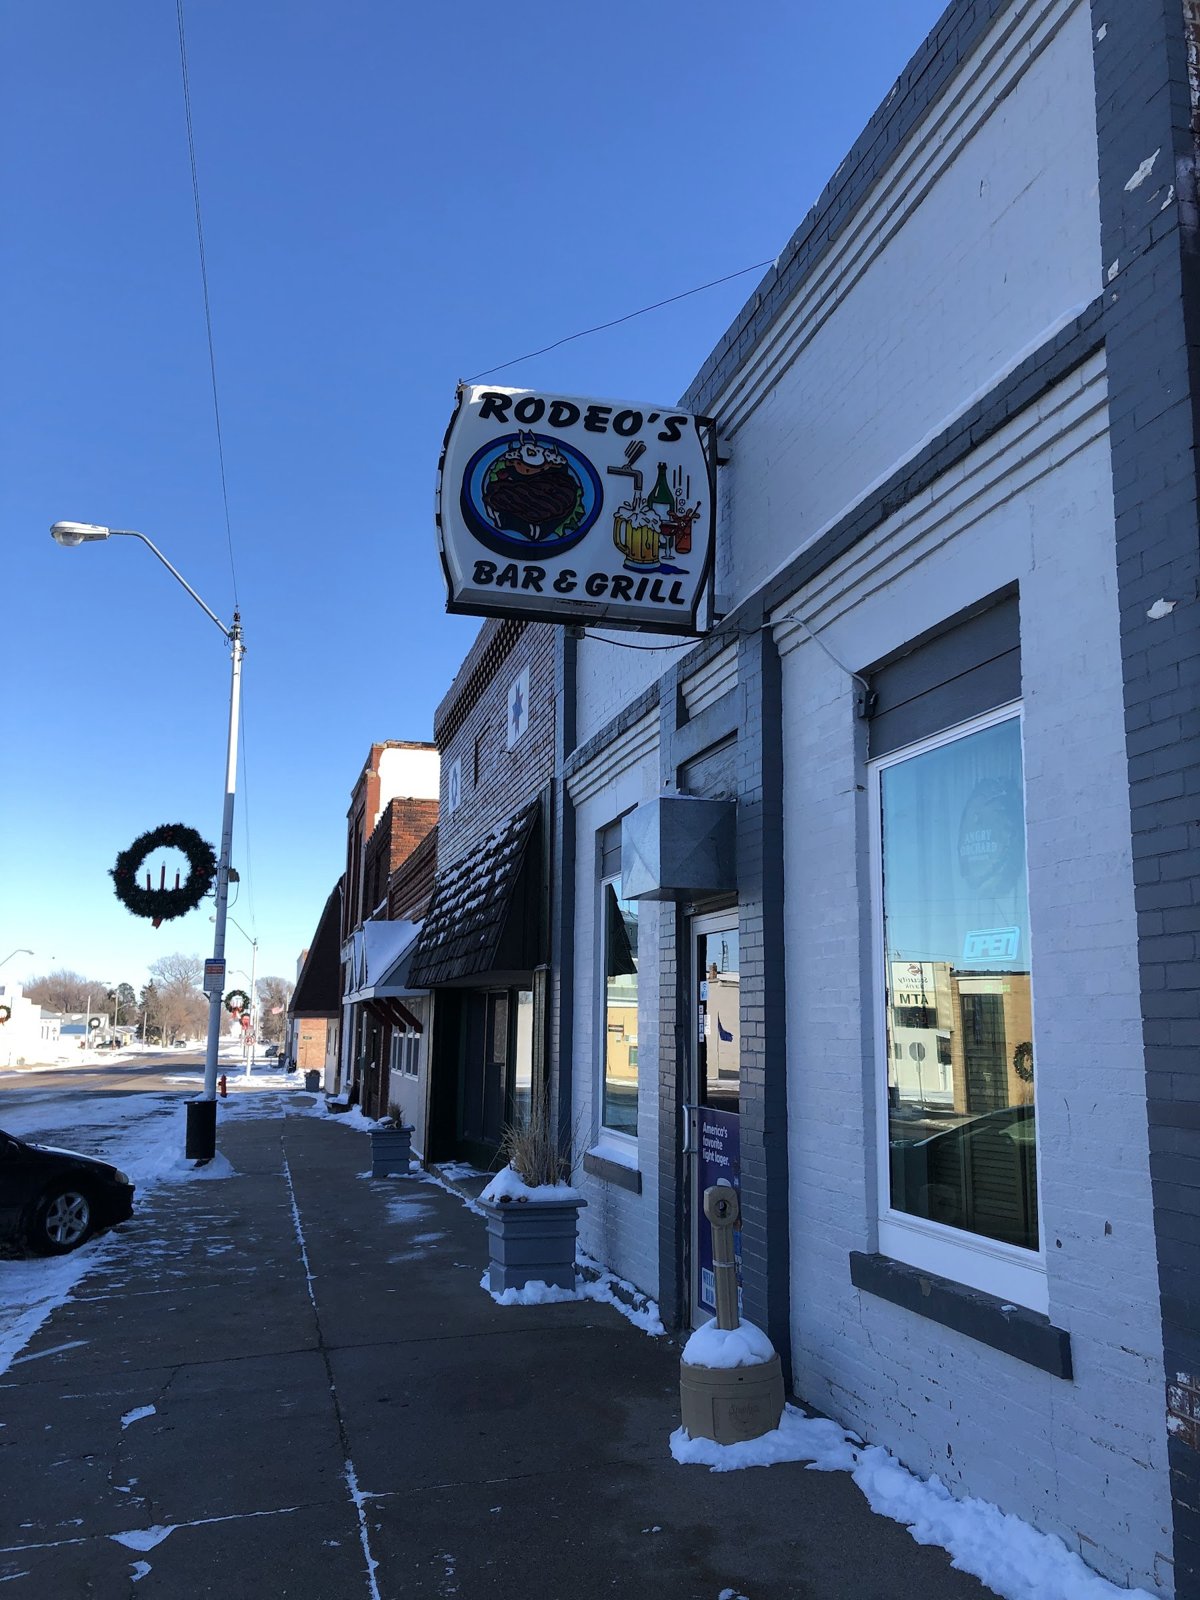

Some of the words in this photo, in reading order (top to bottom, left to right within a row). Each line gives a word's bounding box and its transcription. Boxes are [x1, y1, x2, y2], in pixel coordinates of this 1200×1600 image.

[479, 392, 688, 442] RODEO'S
[472, 560, 547, 593] BAR
[553, 569, 578, 593] &
[585, 572, 686, 606] GRILL
[967, 932, 1015, 957] OPEN
[702, 1121, 728, 1138] America's
[702, 1134, 723, 1150] favorite
[702, 1148, 714, 1162] light
[715, 1150, 730, 1167] lager.
